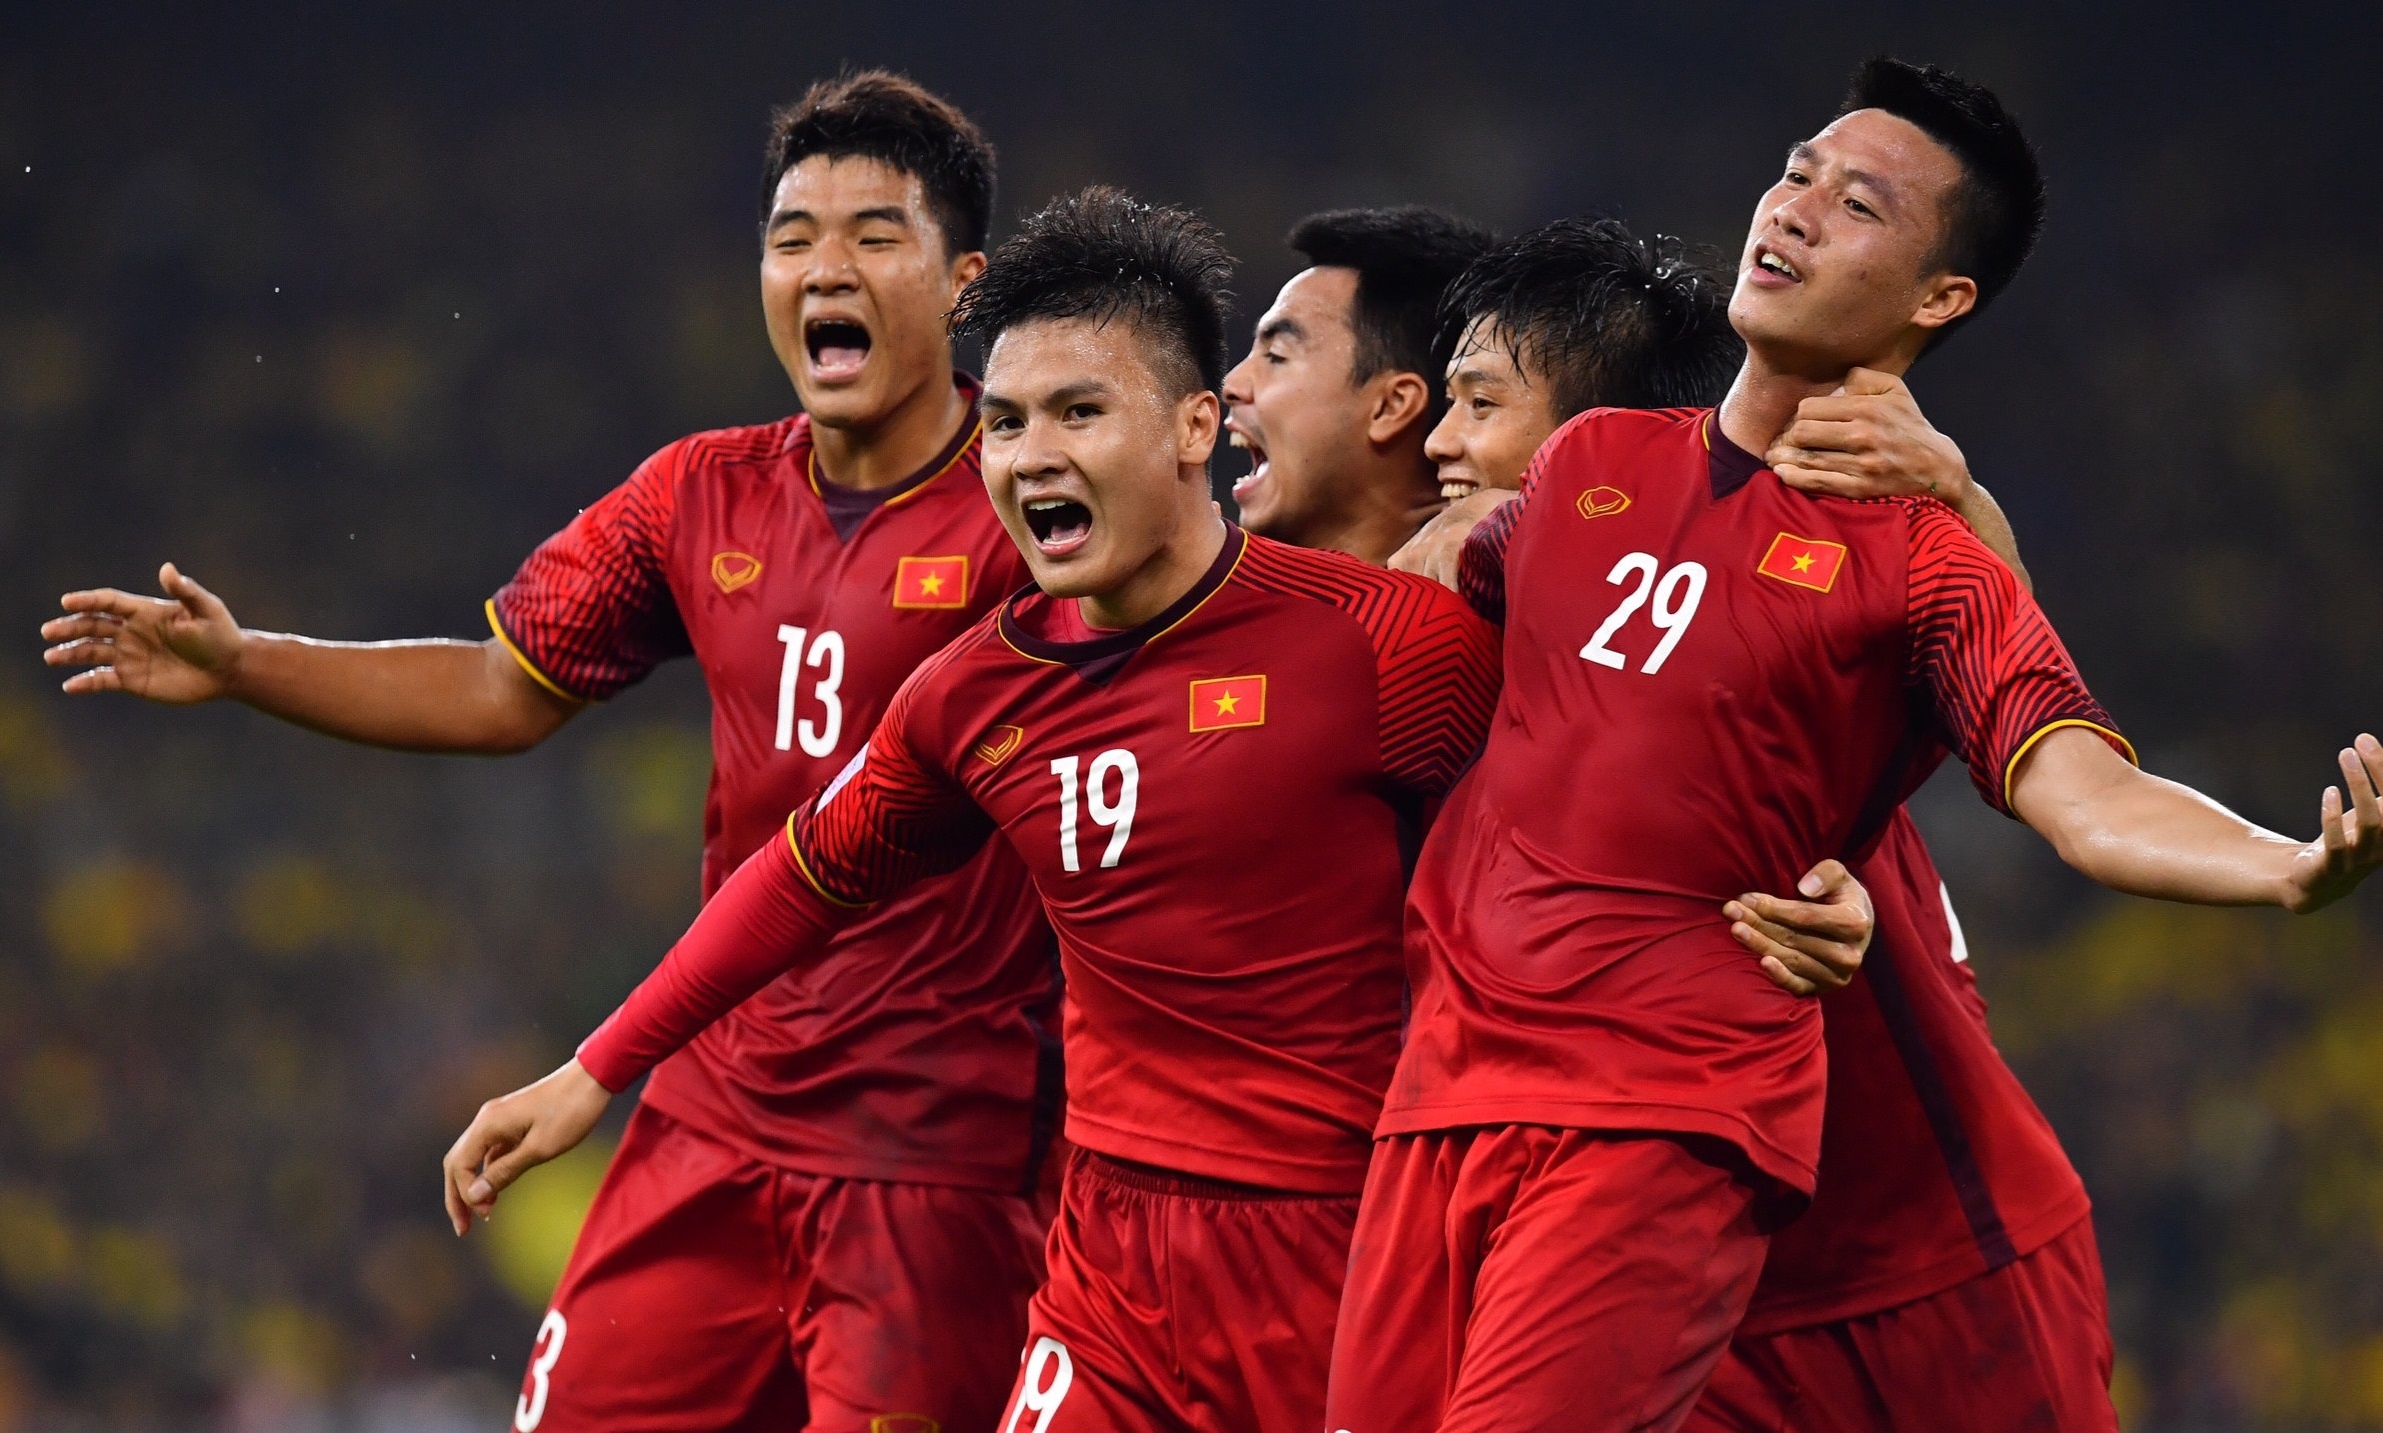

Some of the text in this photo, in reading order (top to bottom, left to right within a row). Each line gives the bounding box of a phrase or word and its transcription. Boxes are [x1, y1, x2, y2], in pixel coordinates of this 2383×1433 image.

[1578, 551, 1708, 675] 29
[774, 623, 845, 758] 13
[1050, 748, 1140, 872] 19
